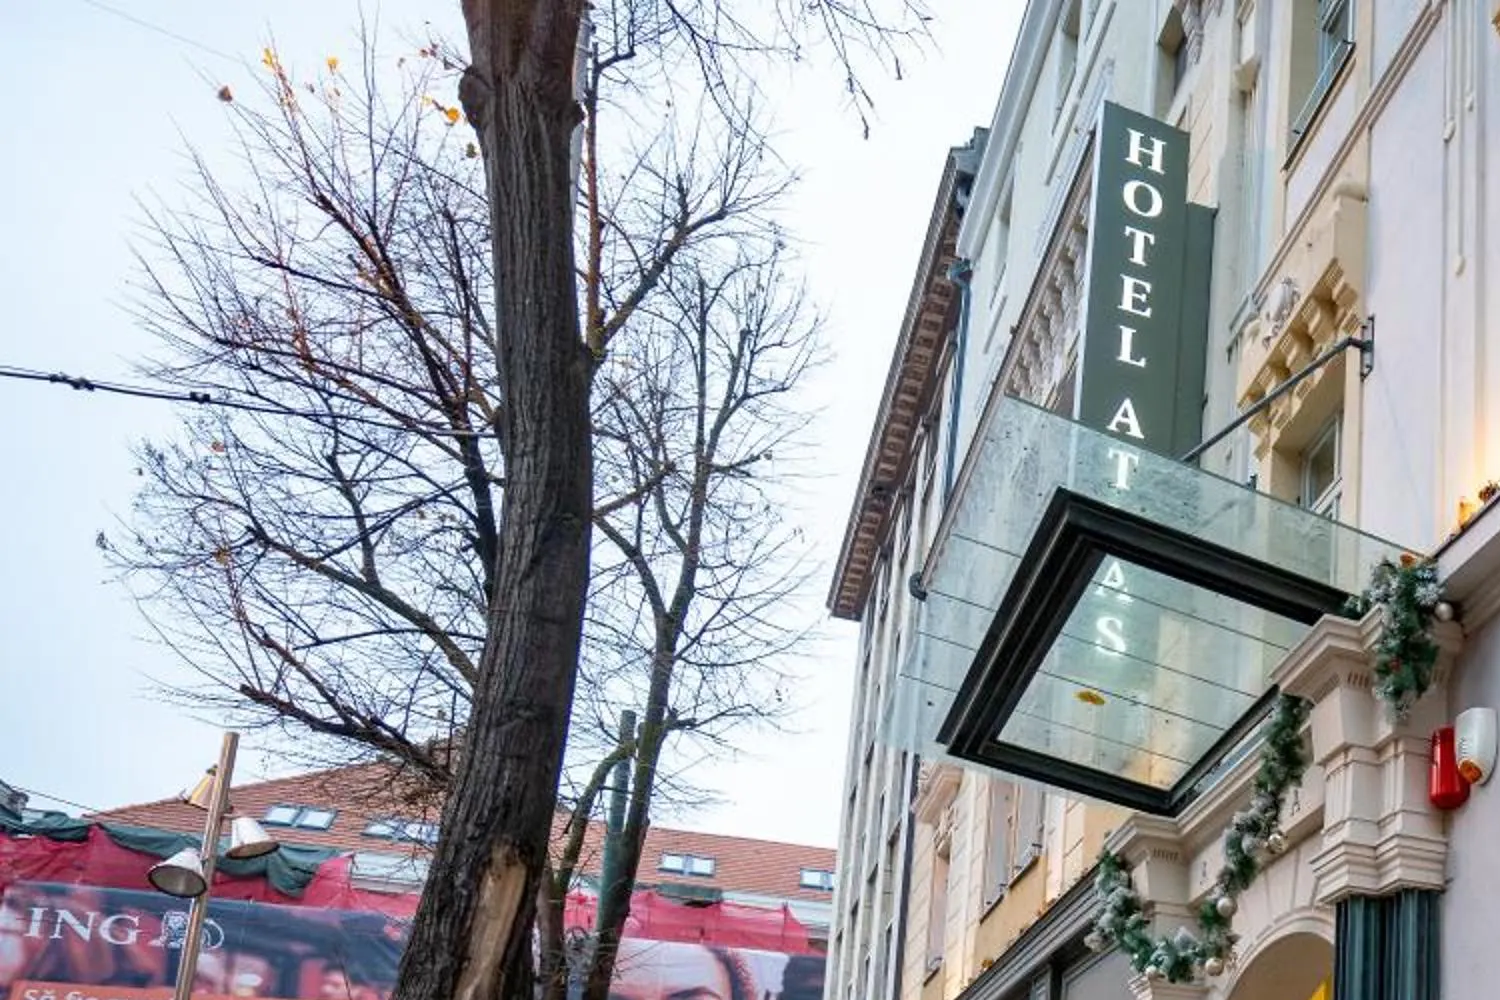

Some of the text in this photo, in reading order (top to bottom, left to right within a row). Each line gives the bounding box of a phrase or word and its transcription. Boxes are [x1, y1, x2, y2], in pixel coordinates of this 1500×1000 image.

[1094, 127, 1168, 659] HOTEL ATAS
[24, 907, 142, 945] ING
